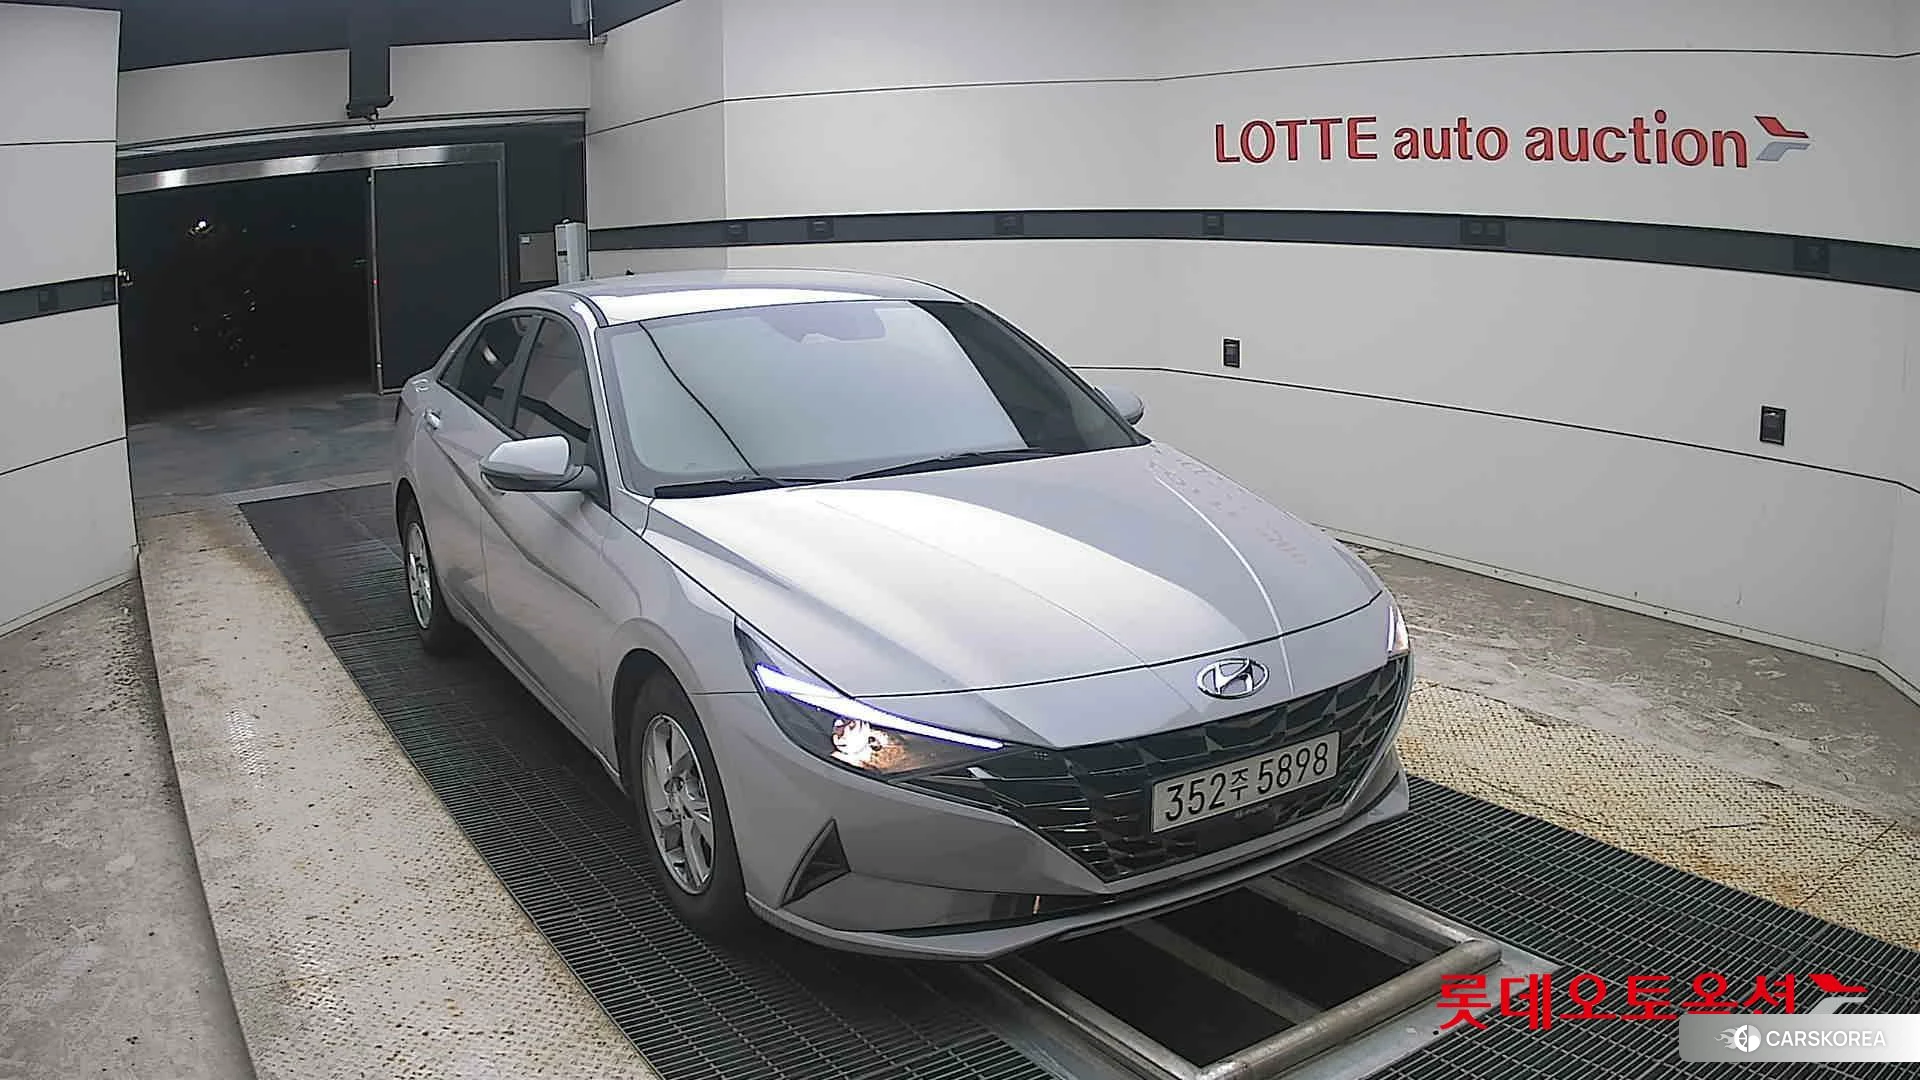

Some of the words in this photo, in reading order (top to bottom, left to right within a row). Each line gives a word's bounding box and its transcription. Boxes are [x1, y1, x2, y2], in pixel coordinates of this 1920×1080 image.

[1215, 116, 1377, 163] LOTTE
[1393, 117, 1508, 162] auto
[1524, 110, 1749, 168] auction
[1164, 767, 1249, 823] 352주
[1256, 742, 1329, 796] 5898
